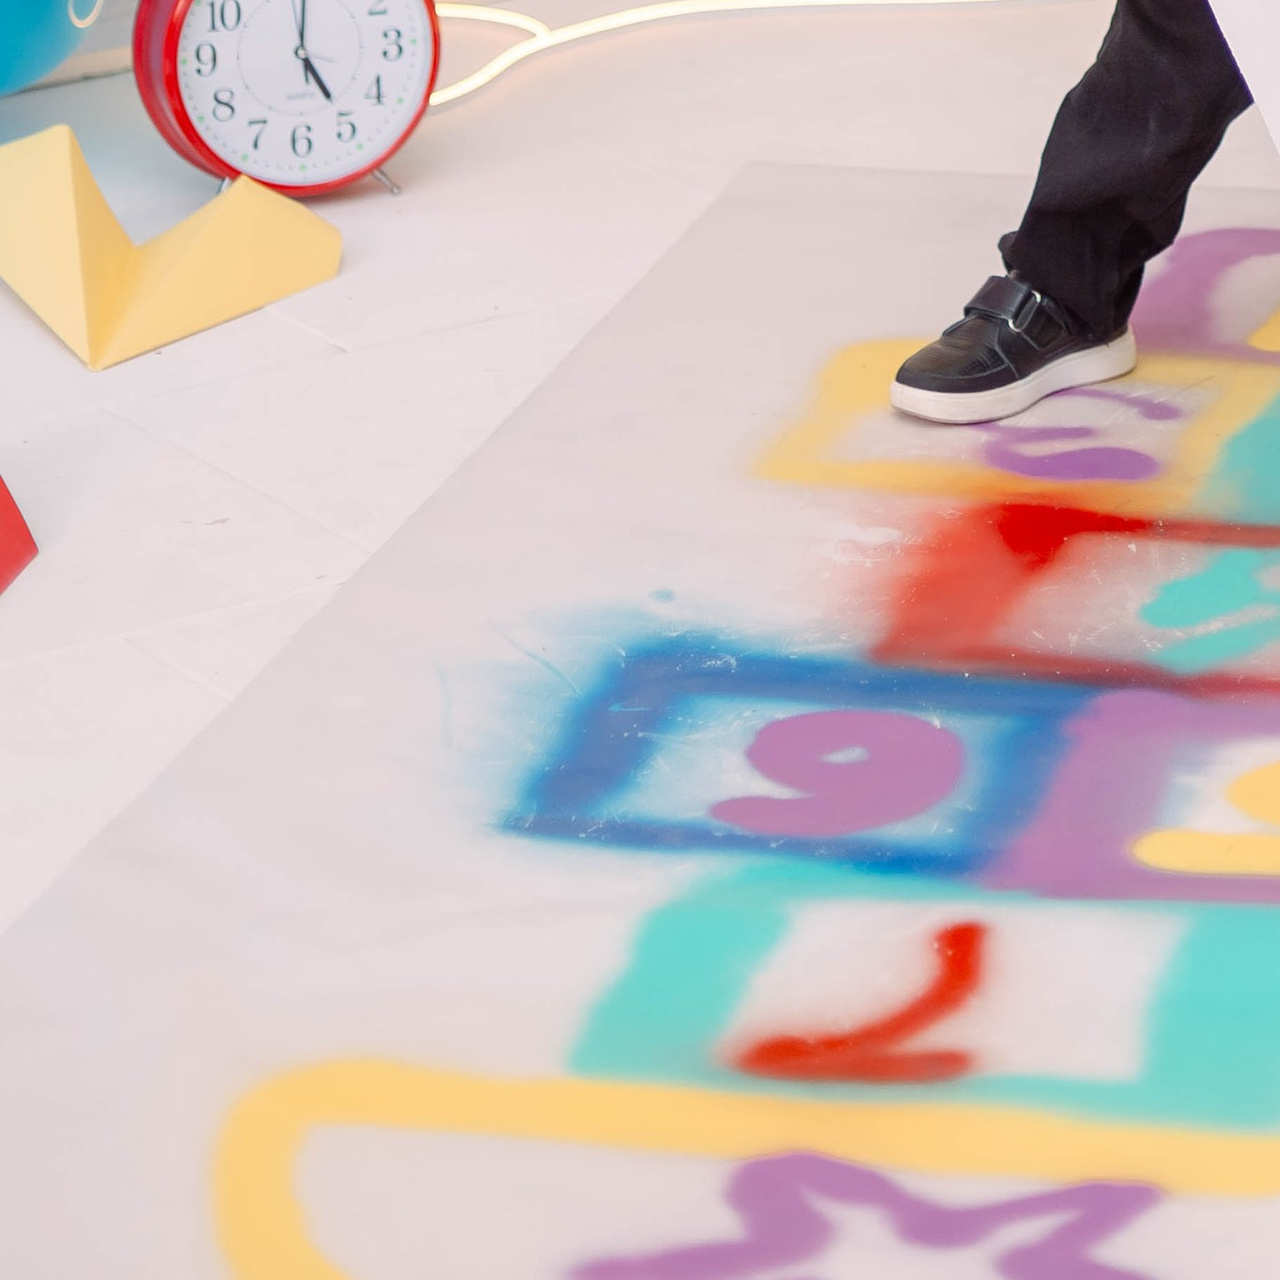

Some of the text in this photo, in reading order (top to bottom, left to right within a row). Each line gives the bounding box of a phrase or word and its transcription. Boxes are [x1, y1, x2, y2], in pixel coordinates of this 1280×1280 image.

[194, 42, 217, 77] 9
[381, 27, 403, 61] 3
[211, 87, 236, 122] 8
[364, 74, 387, 105] 4
[247, 119, 269, 151] 7
[290, 124, 313, 158] 6
[336, 110, 358, 143] 5
